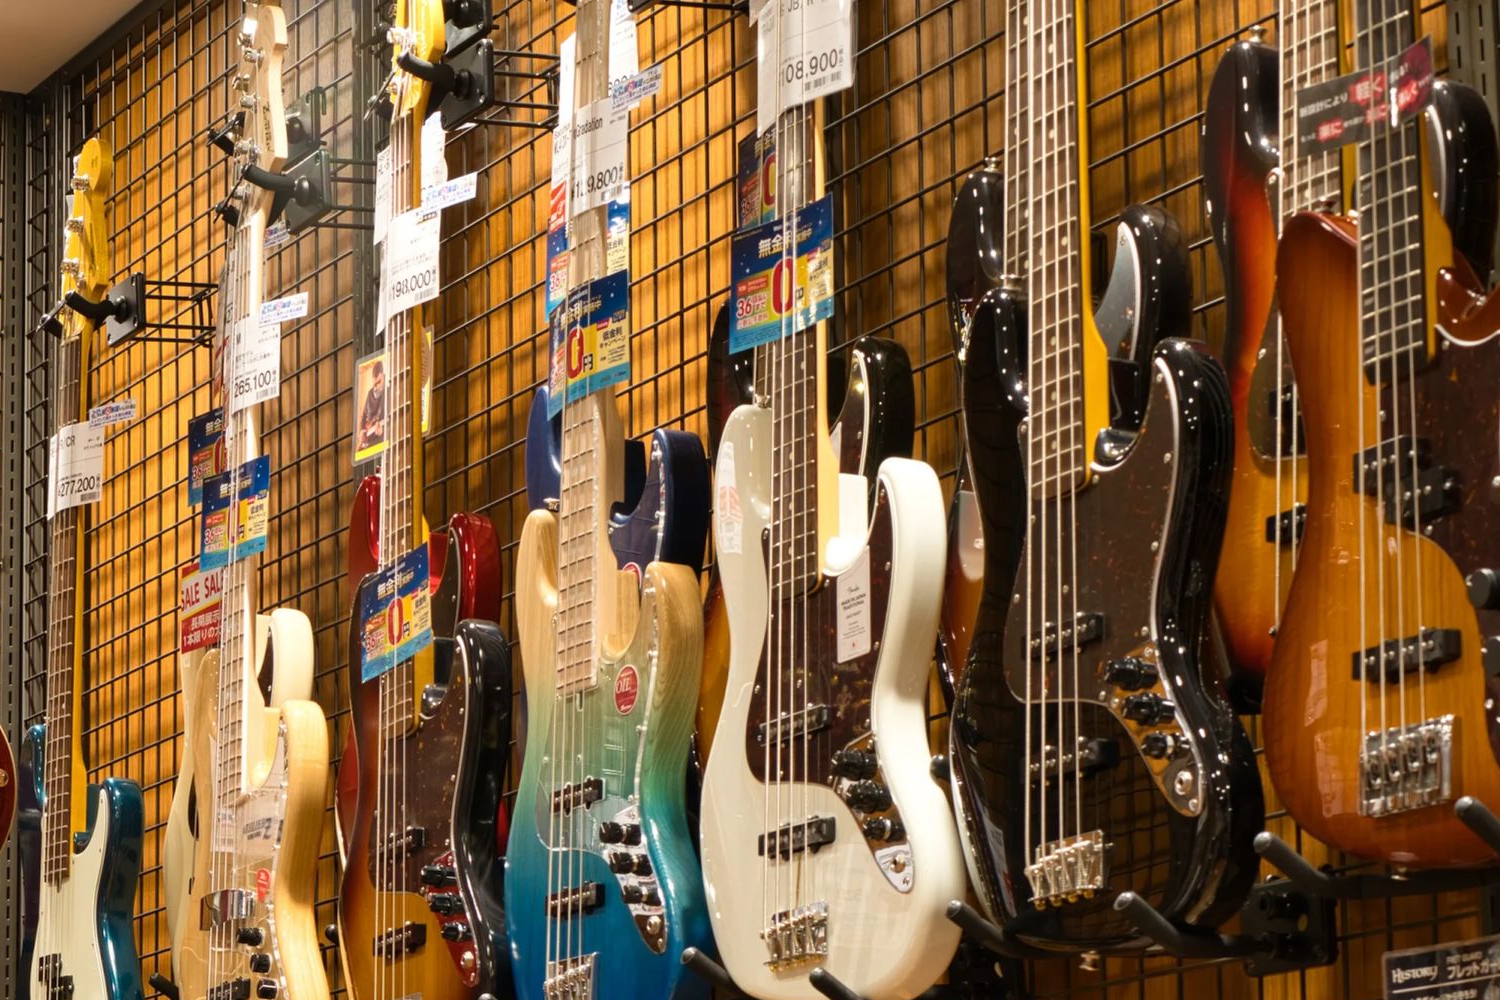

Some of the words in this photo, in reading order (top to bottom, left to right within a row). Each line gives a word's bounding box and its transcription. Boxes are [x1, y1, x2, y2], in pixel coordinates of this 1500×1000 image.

[736, 298, 752, 318] 36
[1447, 958, 1500, 979] フレットガー
